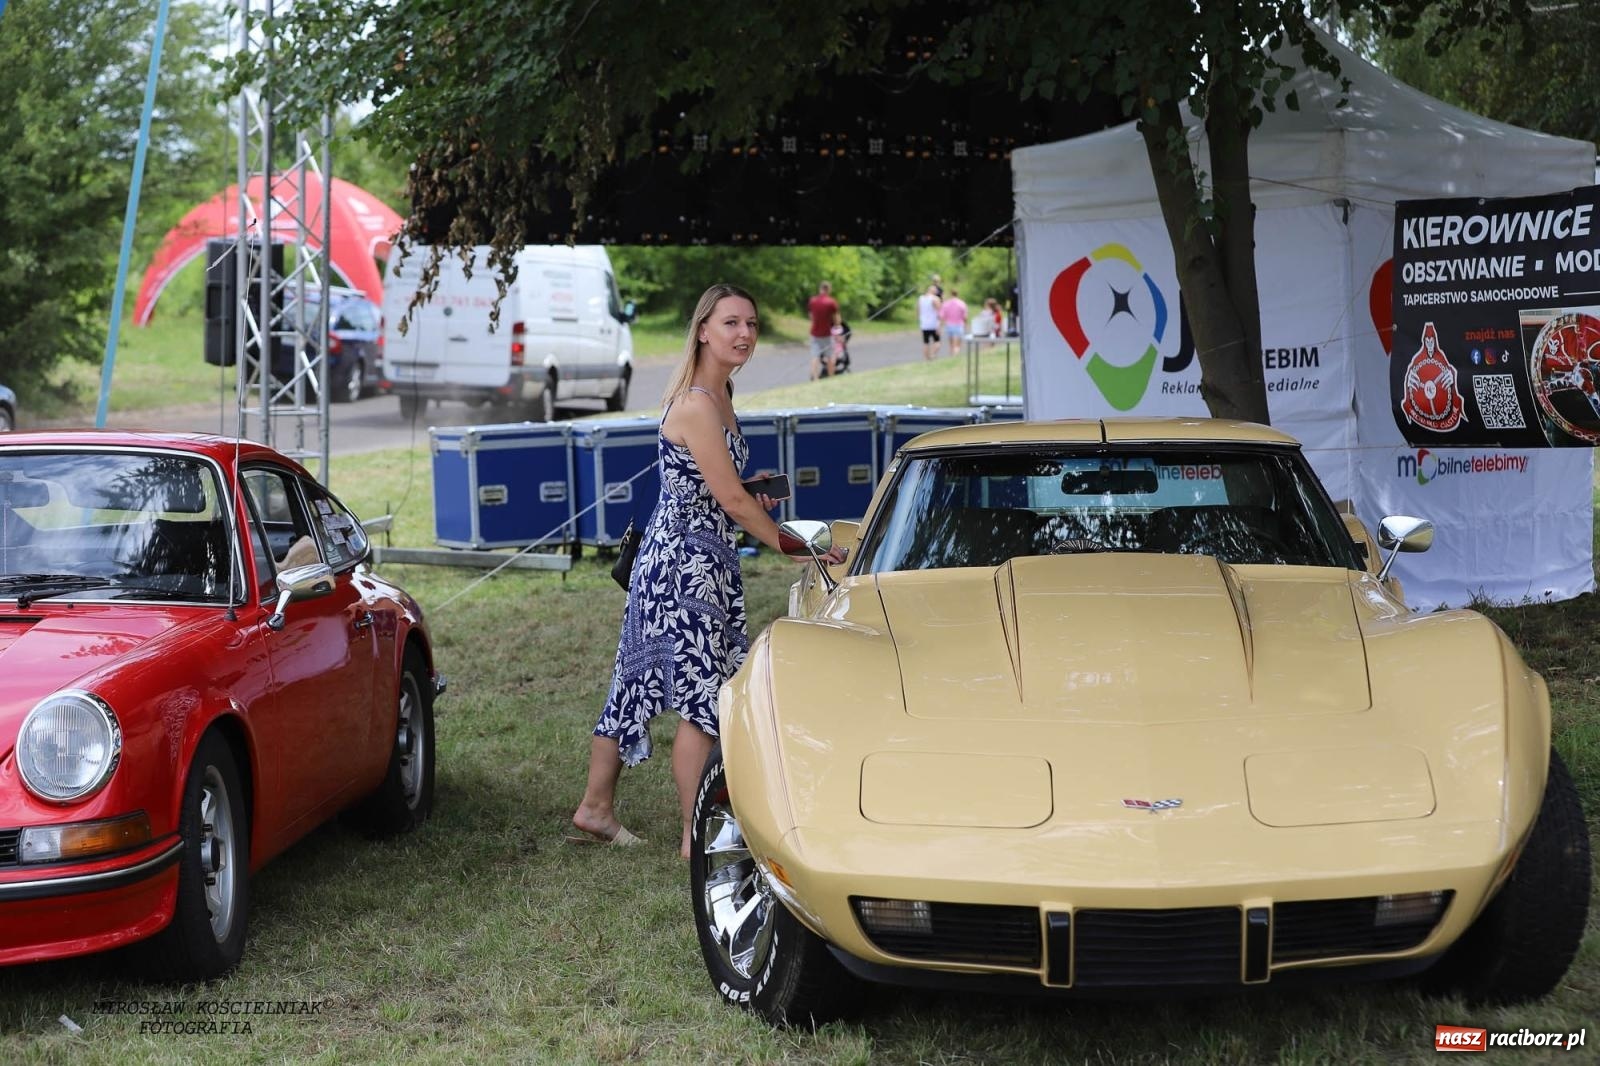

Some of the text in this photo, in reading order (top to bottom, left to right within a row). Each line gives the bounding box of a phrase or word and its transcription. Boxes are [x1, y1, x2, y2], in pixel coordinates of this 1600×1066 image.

[1402, 203, 1594, 249] KIEROWNICE
[1402, 255, 1526, 284] OBSZYWANIE
[1403, 286, 1559, 306] TAPICERSTWO SAMOCHODOWE
[1162, 289, 1196, 373] J
[1497, 329, 1516, 340] nas
[1262, 346, 1320, 369] EBIM
[1267, 377, 1320, 392] edialne
[719, 981, 751, 1003] 500
